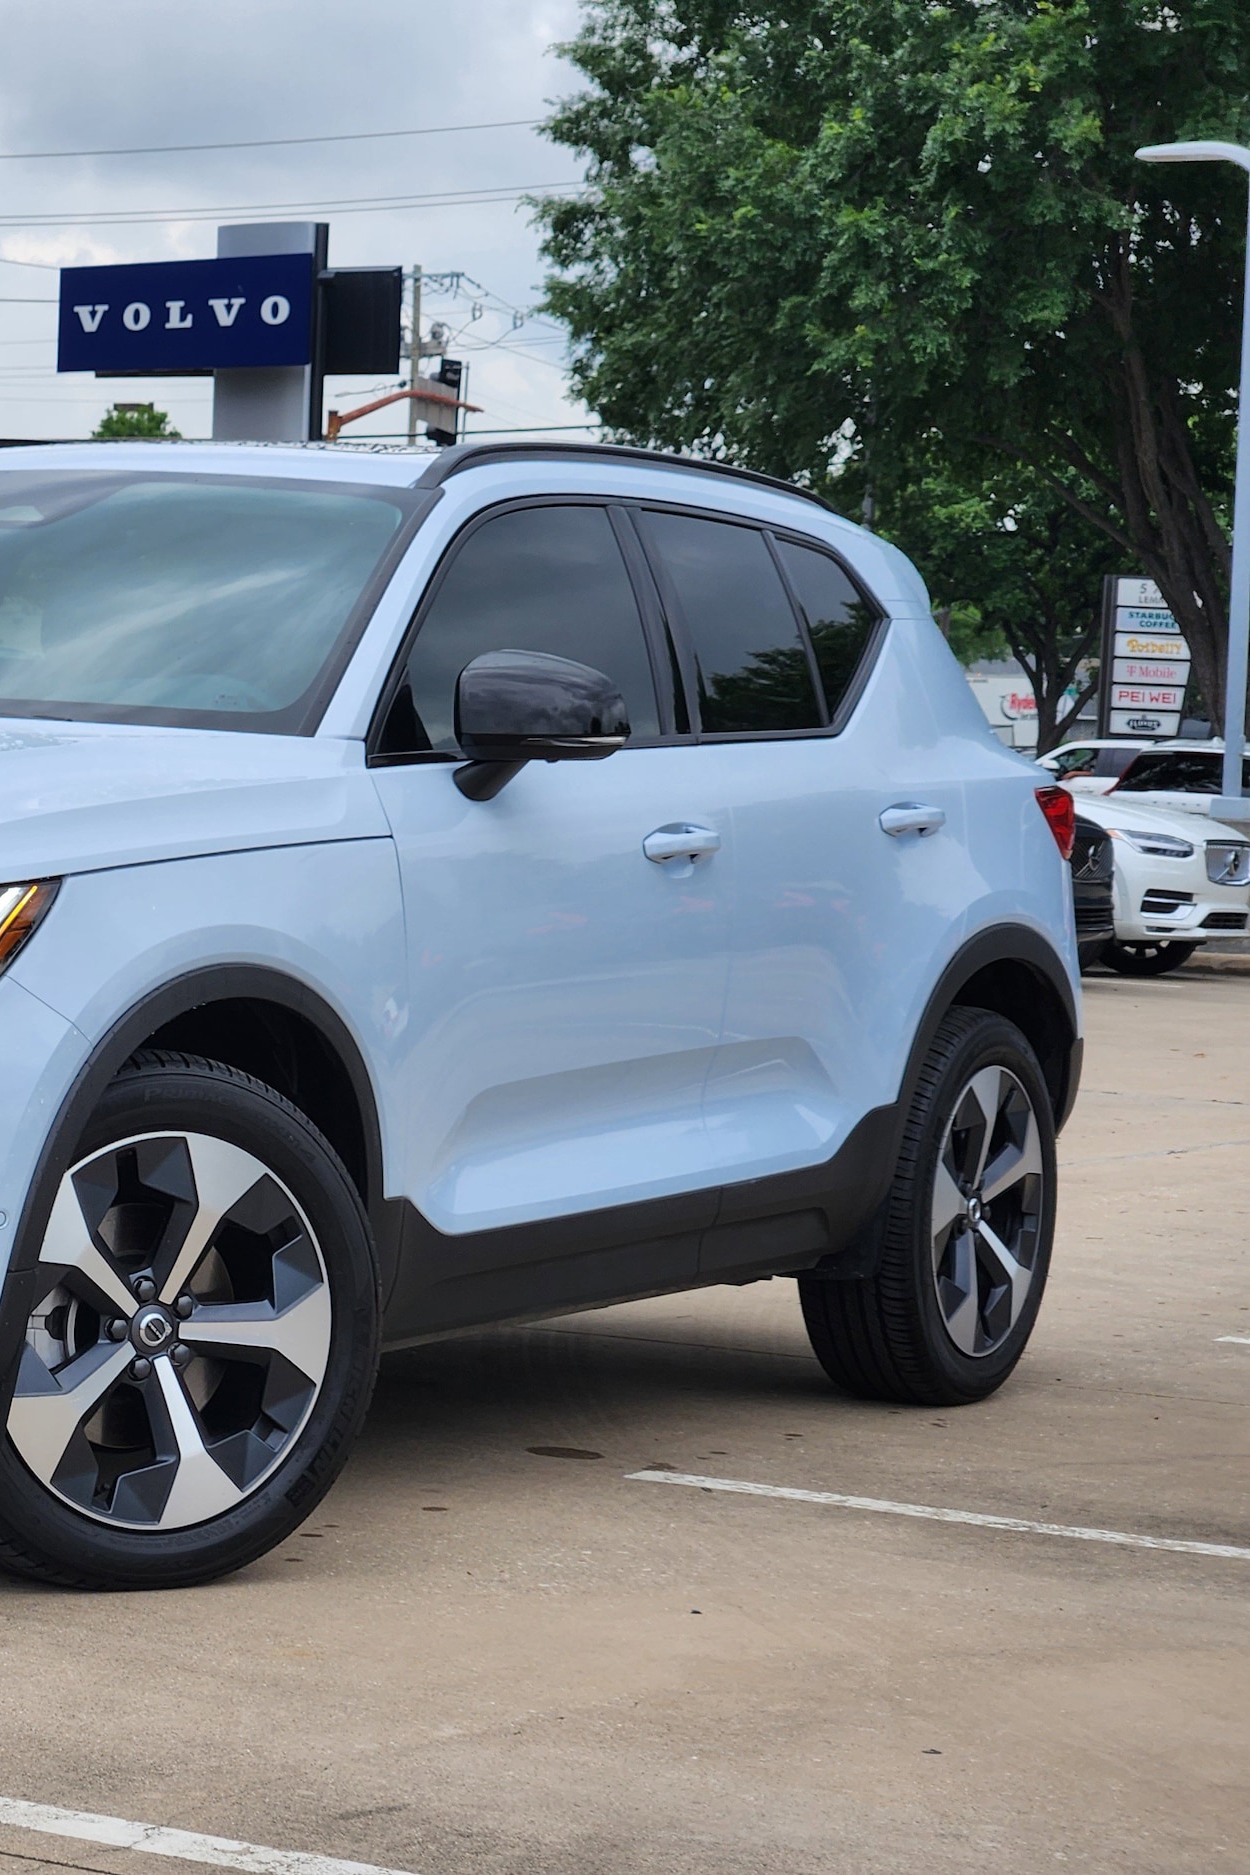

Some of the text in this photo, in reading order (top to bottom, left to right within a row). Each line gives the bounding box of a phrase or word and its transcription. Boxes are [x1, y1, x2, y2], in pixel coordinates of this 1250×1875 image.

[73, 294, 291, 333] VOLVO
[1138, 595, 1164, 605] LEM
[1128, 612, 1174, 620] STARBUC
[1140, 621, 1176, 629] COFFEE
[1118, 690, 1176, 704] PEI WEI
